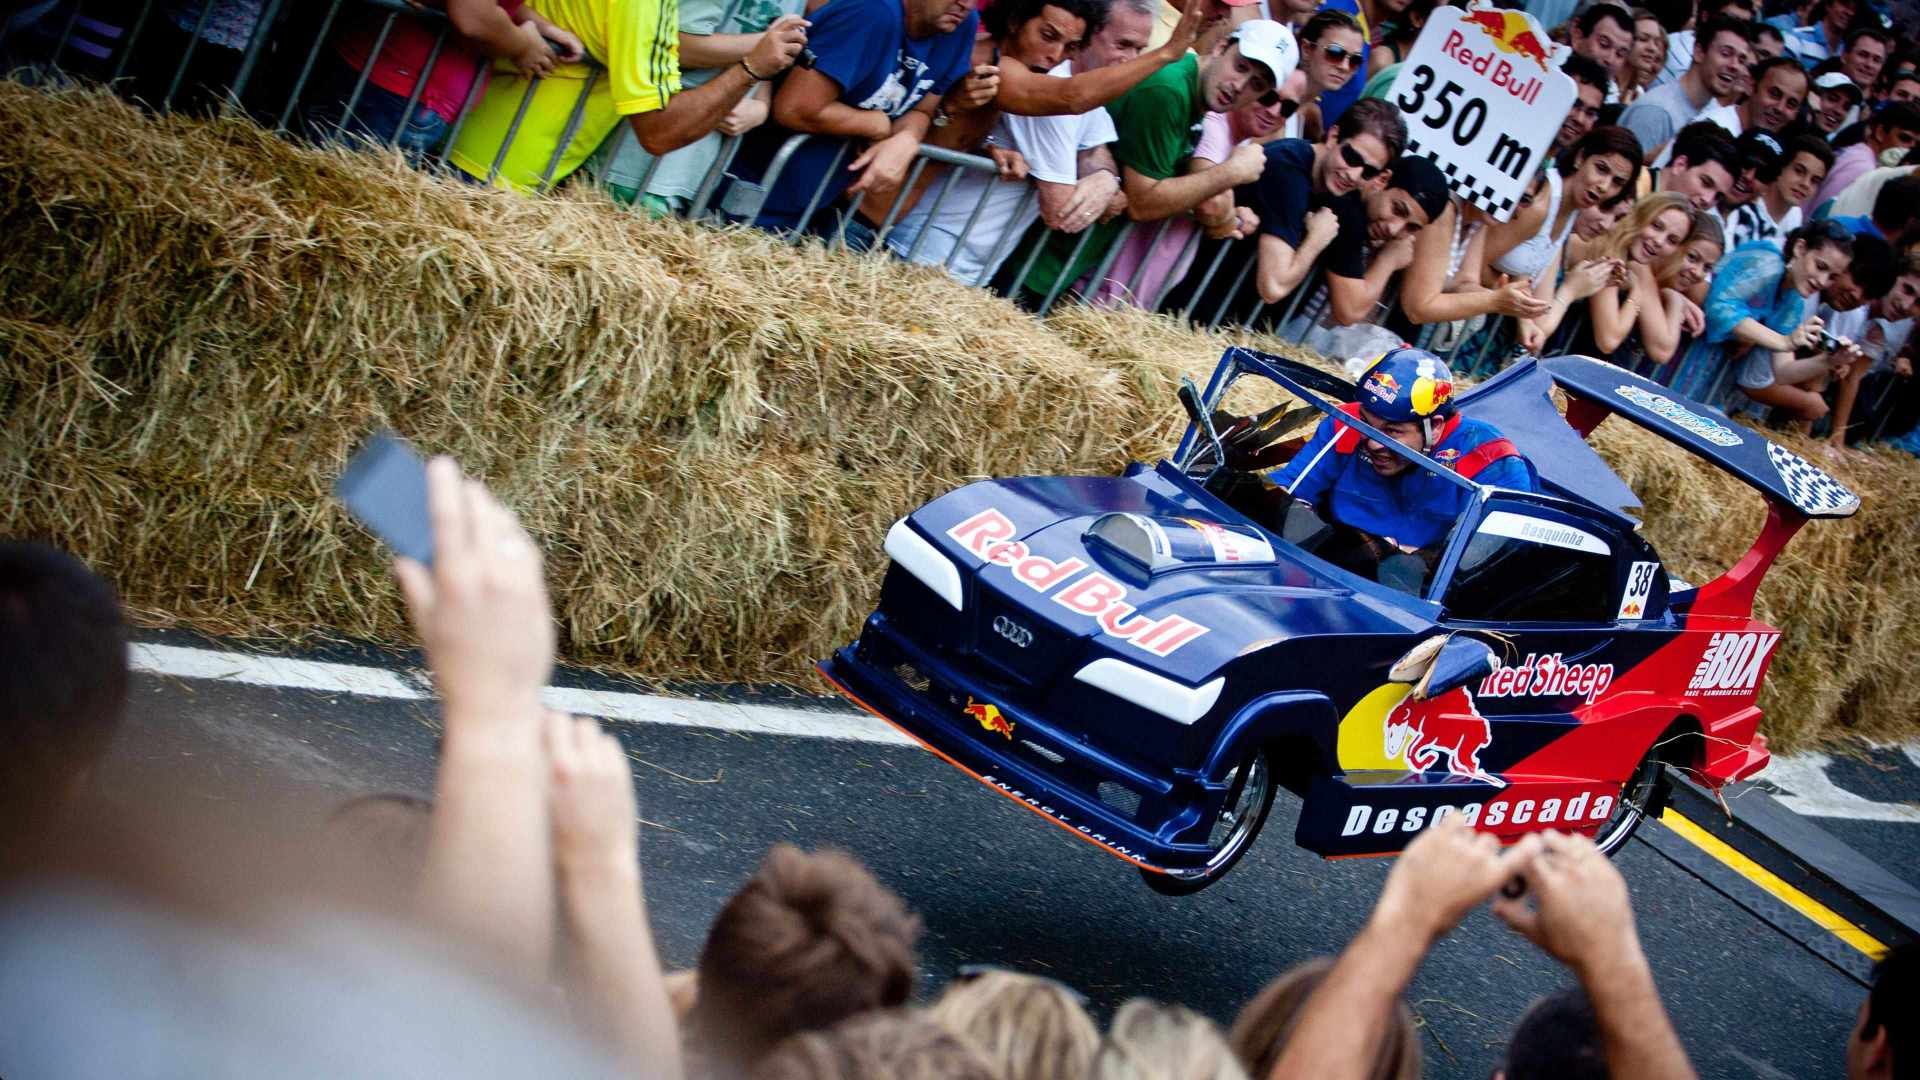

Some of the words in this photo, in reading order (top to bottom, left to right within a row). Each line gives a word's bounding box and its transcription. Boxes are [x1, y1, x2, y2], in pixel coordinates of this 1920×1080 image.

[1442, 29, 1495, 76] Red
[1491, 59, 1543, 106] Bull
[1398, 64, 1488, 147] 350
[1487, 133, 1532, 181] m
[1363, 378, 1384, 397] Red
[1379, 387, 1397, 405] Bull
[1519, 522, 1585, 547] Rasquinha
[946, 508, 1089, 593] Red
[1051, 571, 1211, 657] Bull
[1629, 564, 1652, 597] 38
[1477, 653, 1537, 698] Red
[1530, 652, 1614, 705] Sheep
[1688, 632, 1721, 690] SOAP
[1698, 632, 1780, 689] BOX
[982, 775, 1072, 821] ENERGY
[1077, 825, 1147, 863] DRINK
